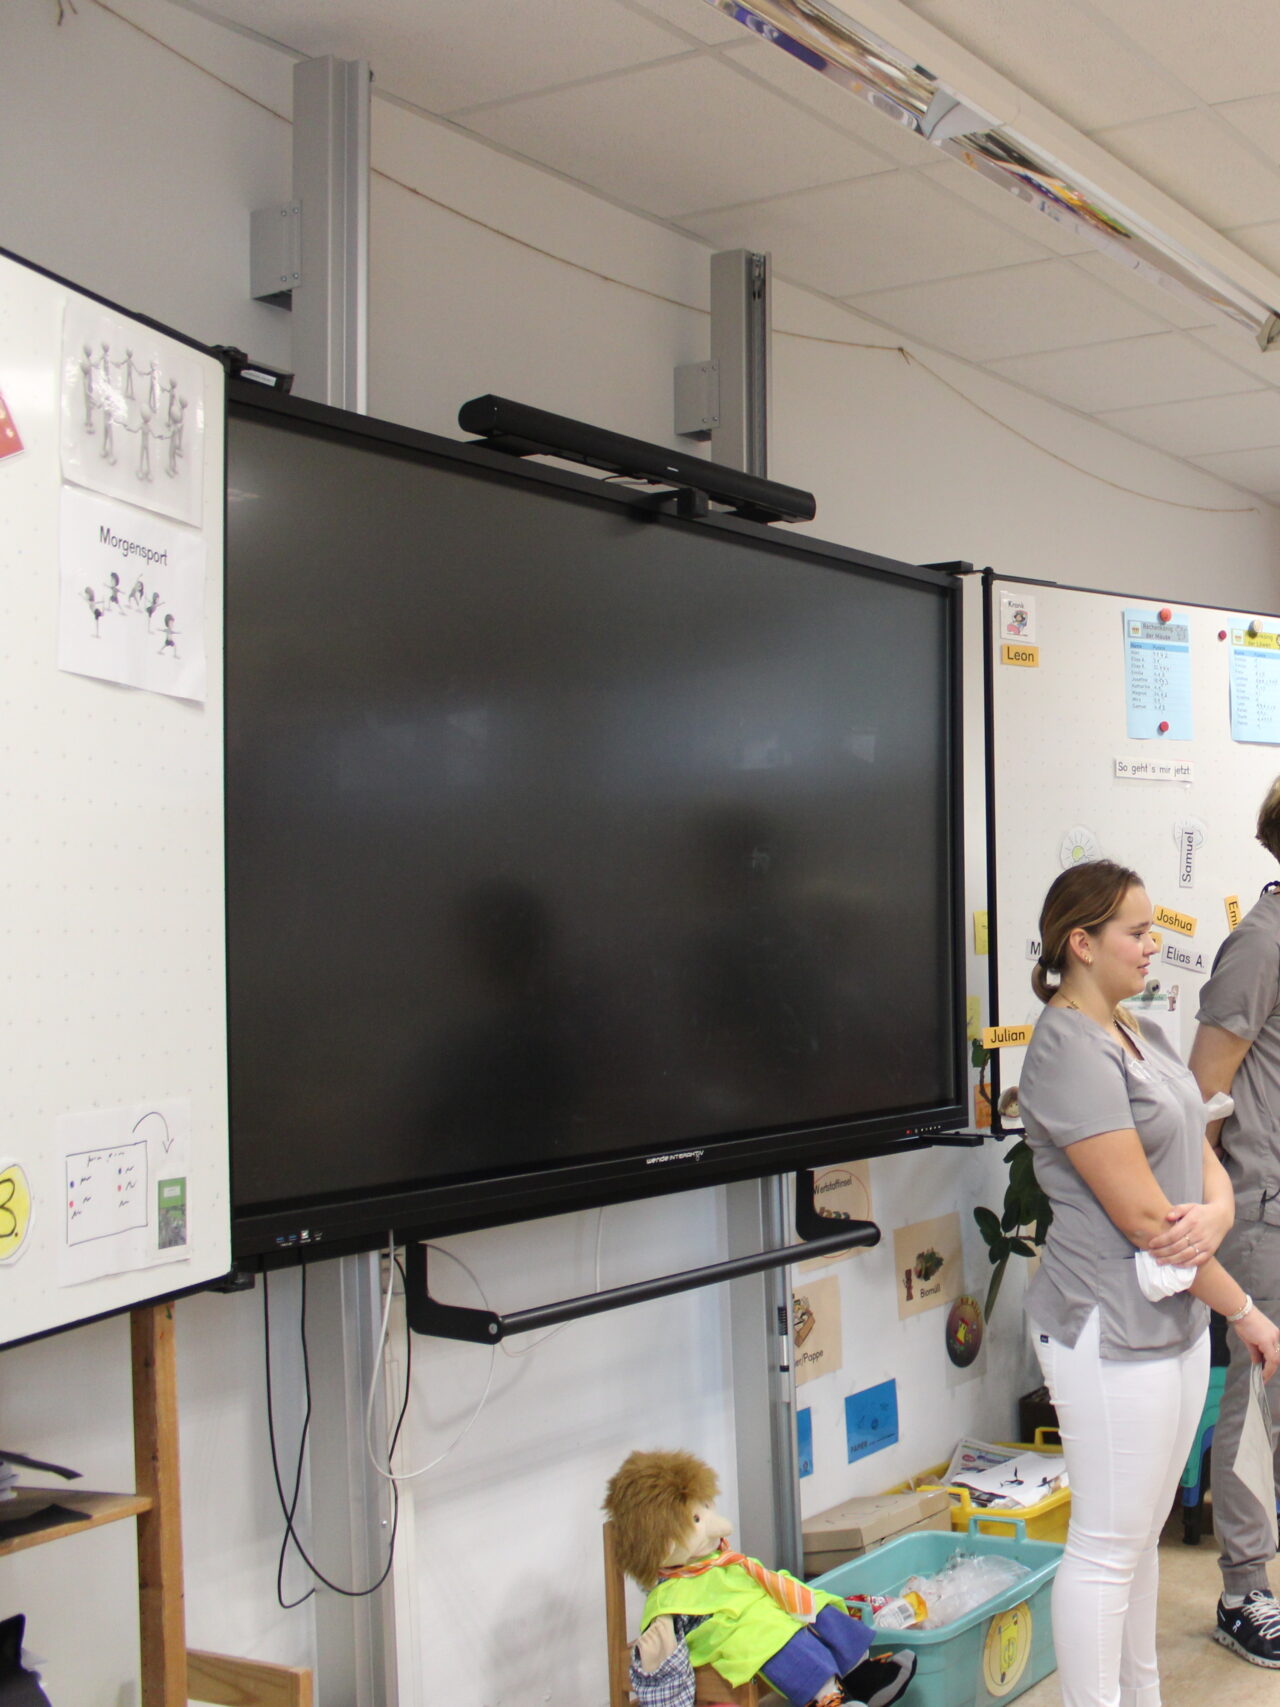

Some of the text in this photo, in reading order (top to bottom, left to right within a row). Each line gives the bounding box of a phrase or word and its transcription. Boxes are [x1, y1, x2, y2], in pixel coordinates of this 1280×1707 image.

[99, 525, 168, 566] Morgensport
[1007, 646, 1035, 662] Leon
[1118, 761, 1128, 772] So
[1159, 765, 1171, 774] mir
[1182, 831, 1194, 883] Samuel
[1156, 909, 1193, 932] Joshua
[1166, 945, 1191, 964] Elias
[990, 1028, 1026, 1044] Julian
